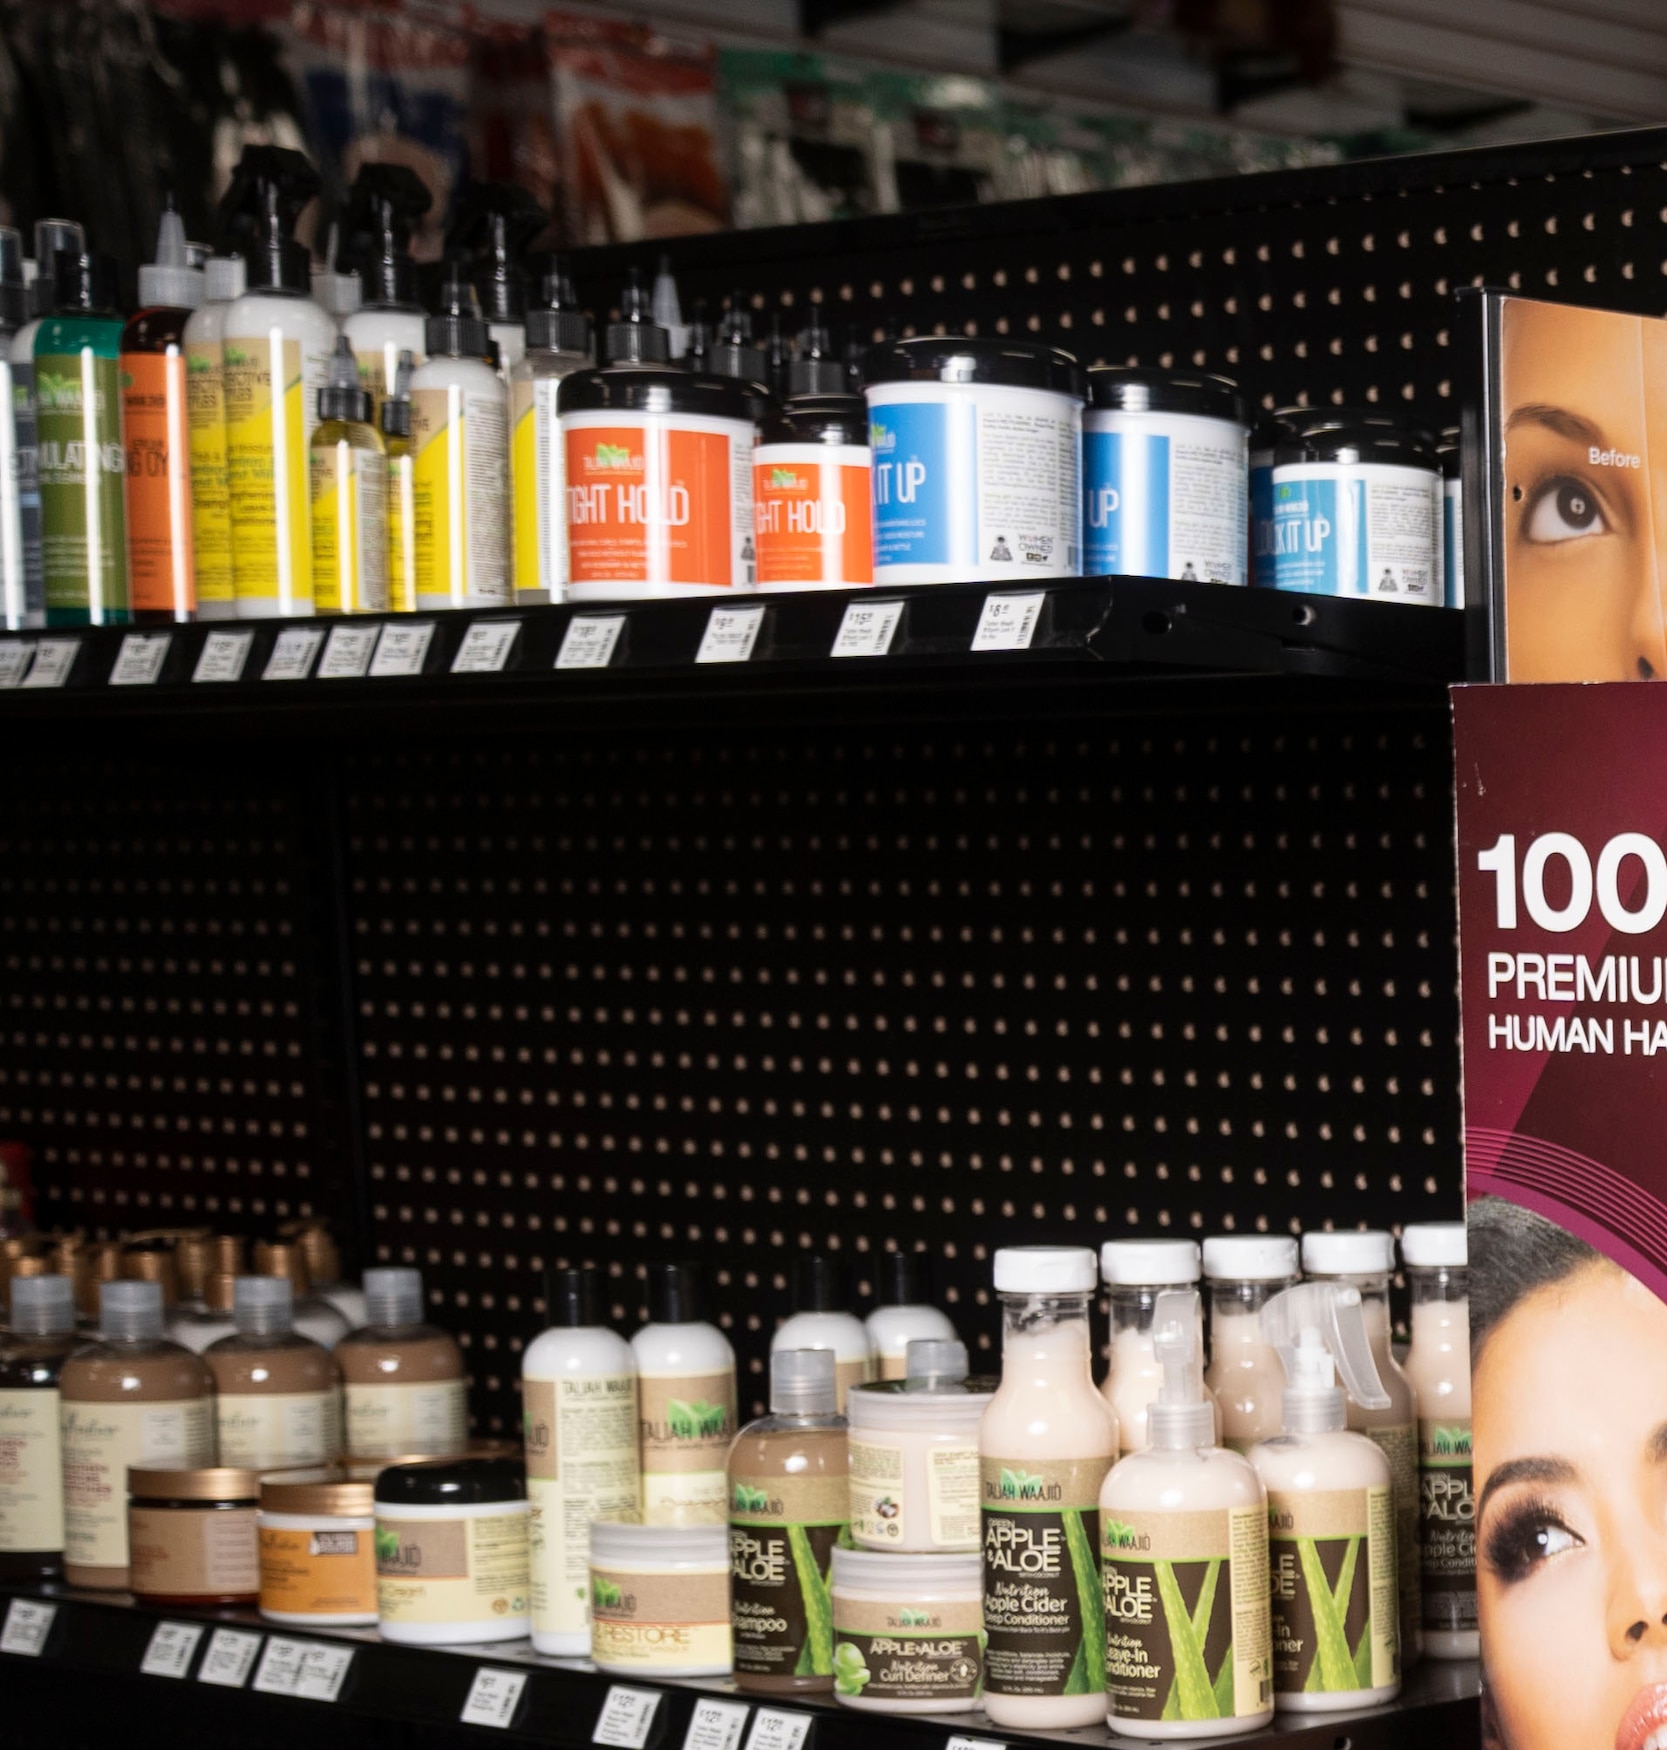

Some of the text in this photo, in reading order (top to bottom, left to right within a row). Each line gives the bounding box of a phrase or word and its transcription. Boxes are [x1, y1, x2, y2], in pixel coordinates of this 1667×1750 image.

[1588, 448, 1640, 471] Before
[896, 461, 926, 503] UP
[617, 484, 690, 527] HOLD
[1089, 488, 1120, 528] UP
[755, 499, 846, 536] GHT HOLD
[1304, 520, 1331, 553] UP
[1488, 1016, 1616, 1055] HUMAN
[1422, 1479, 1473, 1501] APPL
[985, 1528, 1061, 1550] APPLE
[995, 1581, 1049, 1596] Nutrition
[985, 1597, 1067, 1613] Apple Cider
[1105, 1598, 1153, 1619] ALOE
[1005, 1614, 1070, 1626] Conditioner
[607, 1628, 690, 1643] RESTORE
[880, 1669, 950, 1682] Curl Definer
